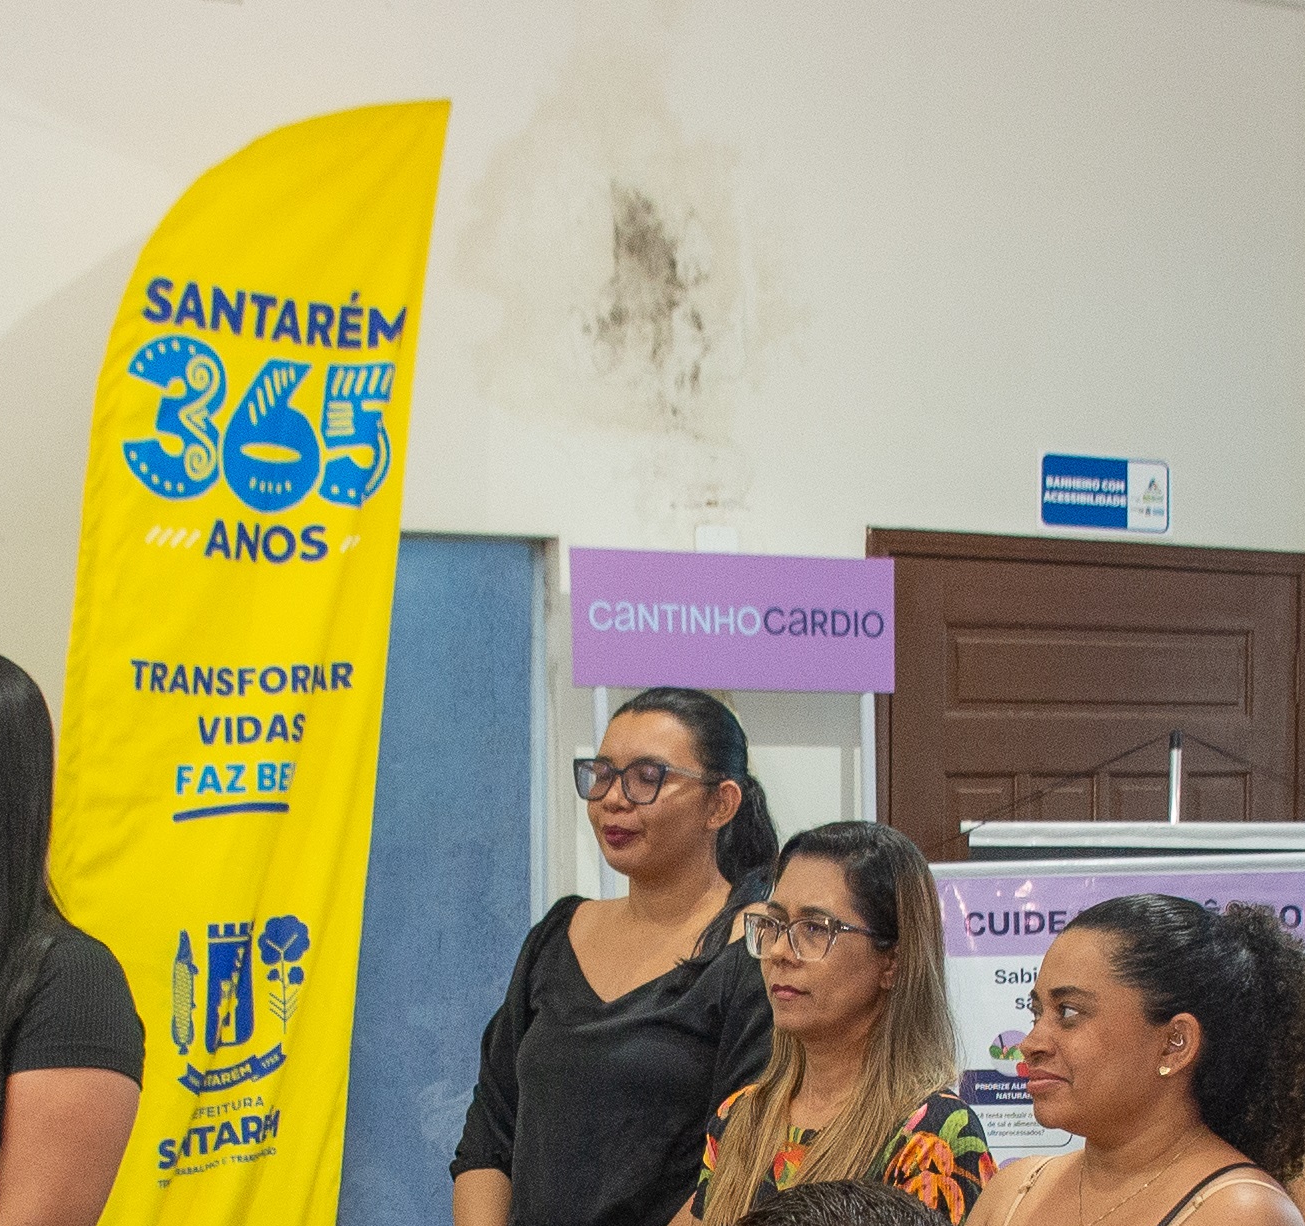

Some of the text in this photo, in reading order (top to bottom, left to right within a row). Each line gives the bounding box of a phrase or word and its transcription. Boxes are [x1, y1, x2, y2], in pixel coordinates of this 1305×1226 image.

[141, 276, 407, 351] SANTARÉM
[122, 333, 396, 514] 365
[203, 519, 329, 564] ANOS
[197, 712, 306, 746] VIDAS
[176, 761, 297, 795] FAZ BE
[965, 910, 1067, 937] CUIDE
[995, 967, 1038, 985] Sabi
[974, 1082, 1010, 1091] PRIORIZE
